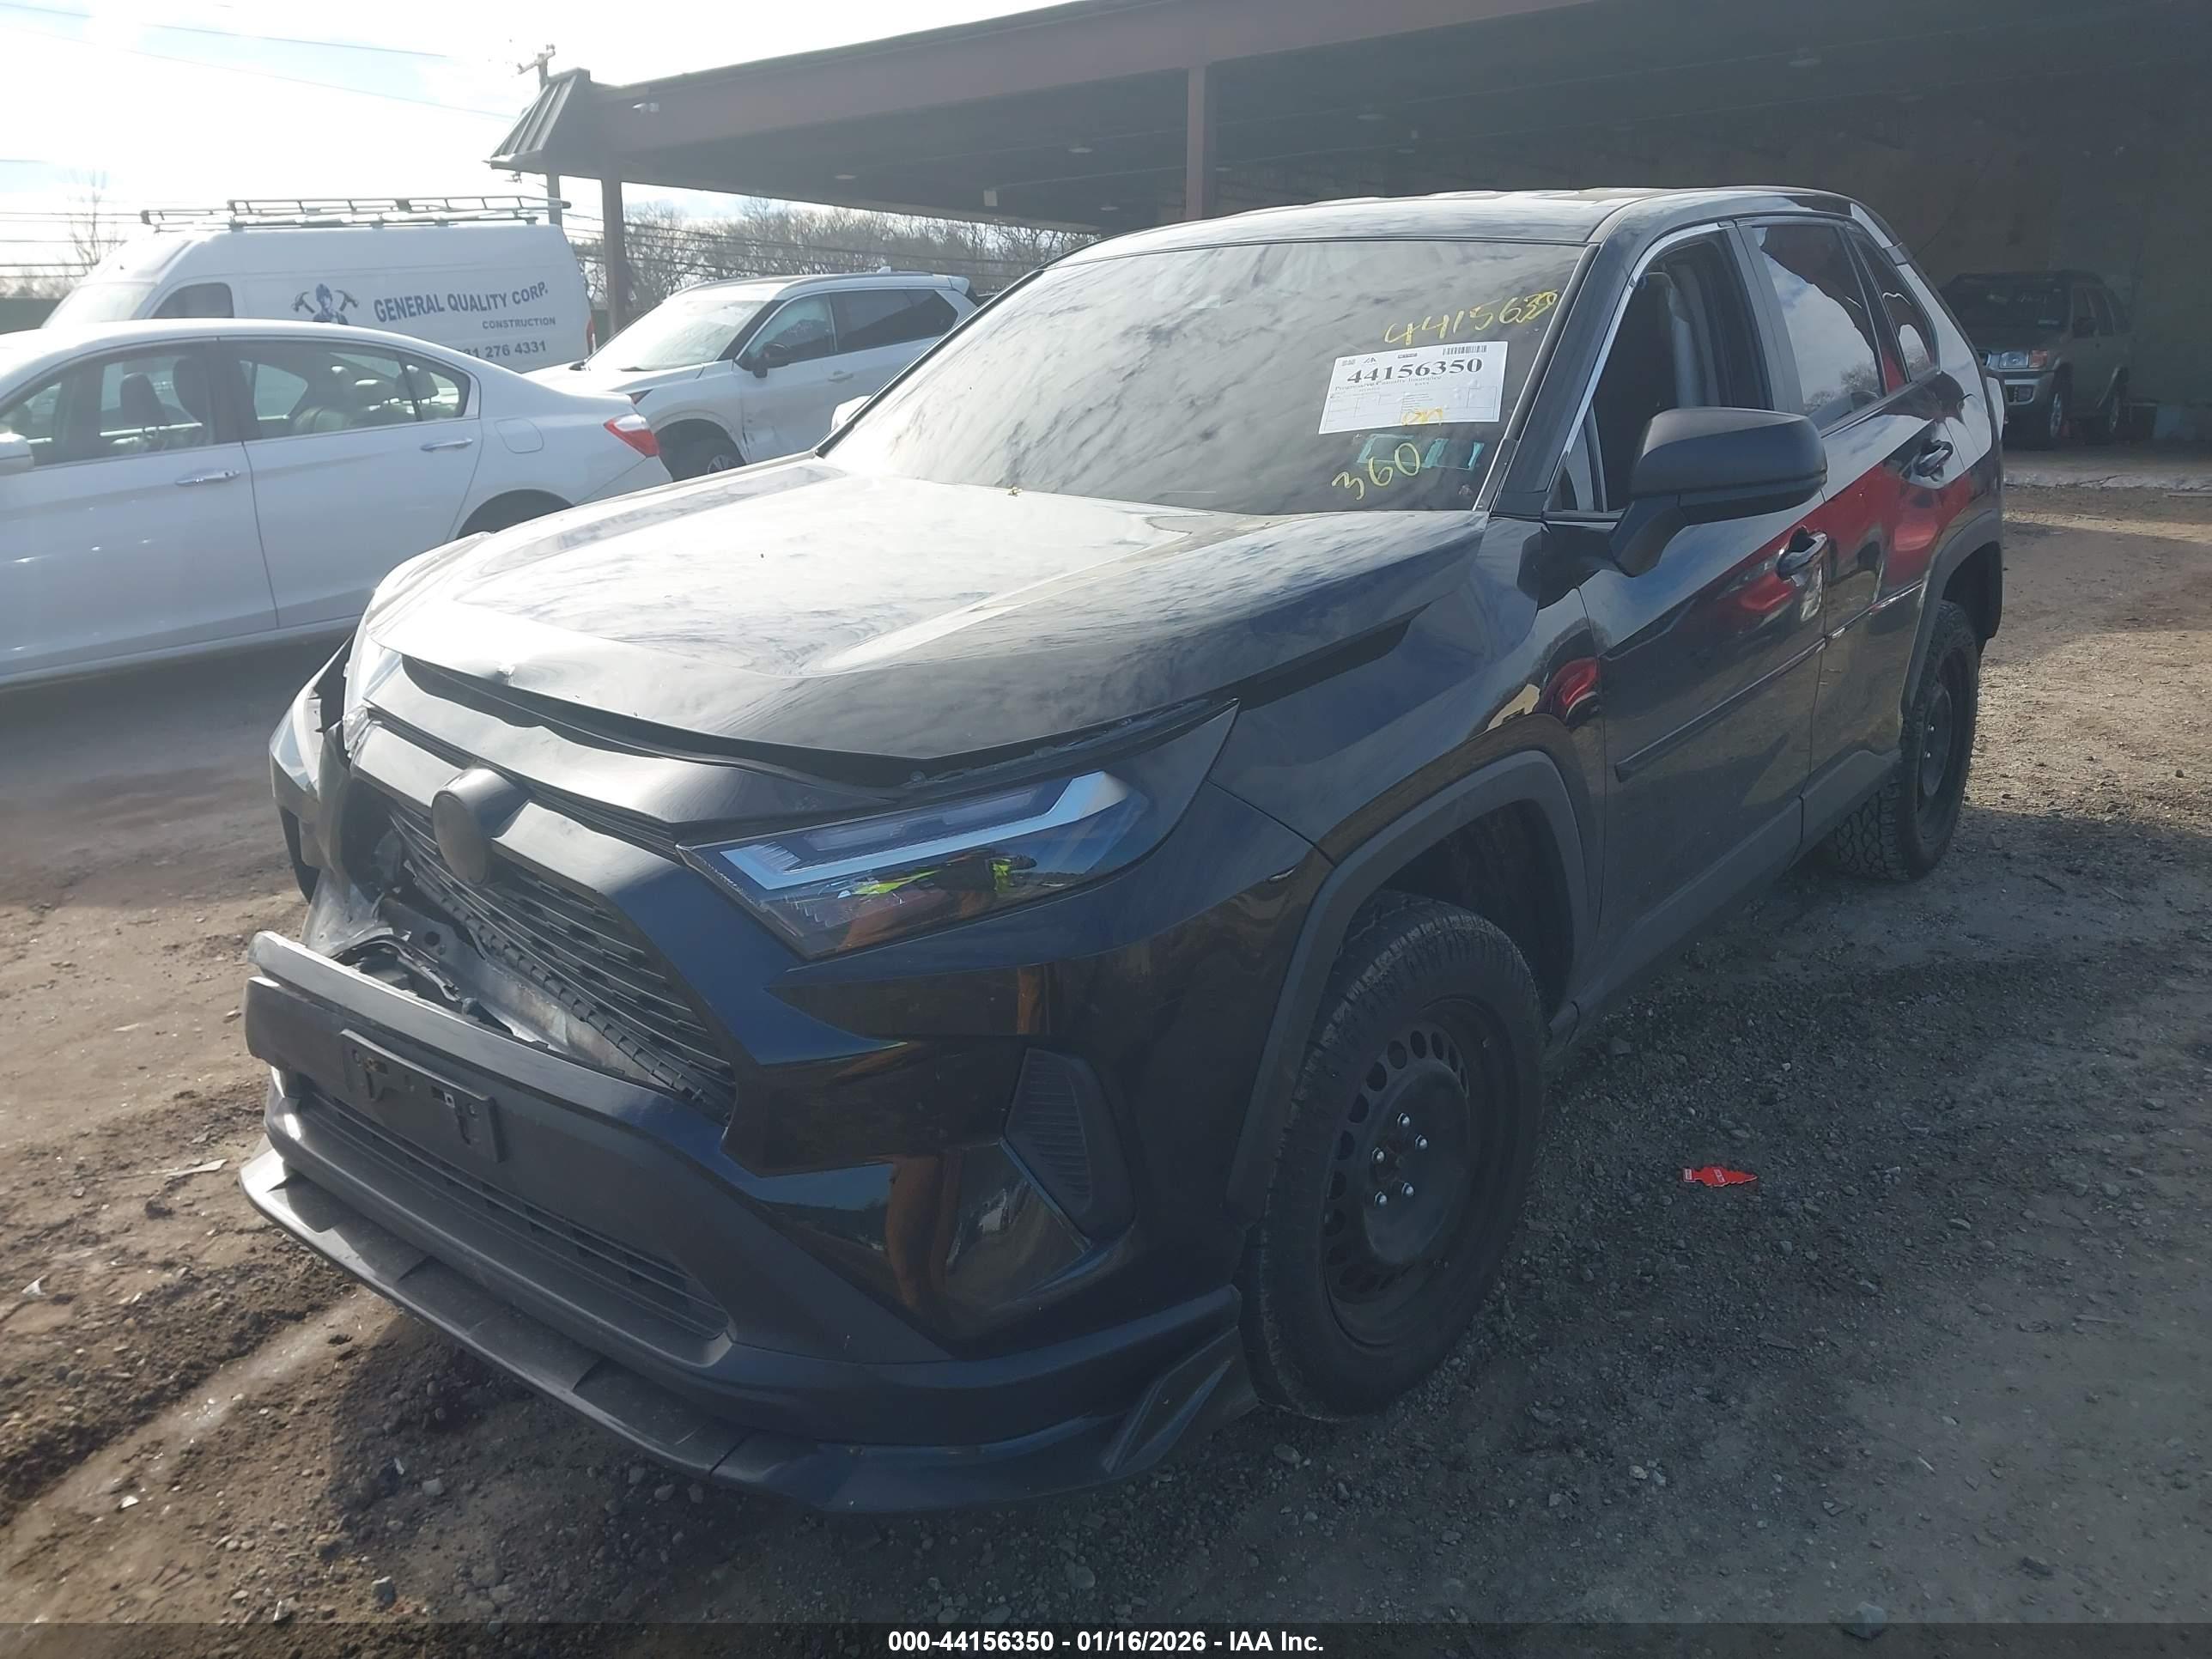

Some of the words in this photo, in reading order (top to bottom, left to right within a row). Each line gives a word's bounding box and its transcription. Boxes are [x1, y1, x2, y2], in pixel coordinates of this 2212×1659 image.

[374, 294, 445, 324] GENERAL
[447, 292, 508, 313] QUALITY
[512, 281, 549, 306] CORP.
[483, 317, 556, 329] CONSTRUCTION
[485, 345, 511, 360] 276
[514, 340, 547, 355] 4331
[1346, 358, 1483, 384] 44156350
[1331, 443, 1420, 500] 360
